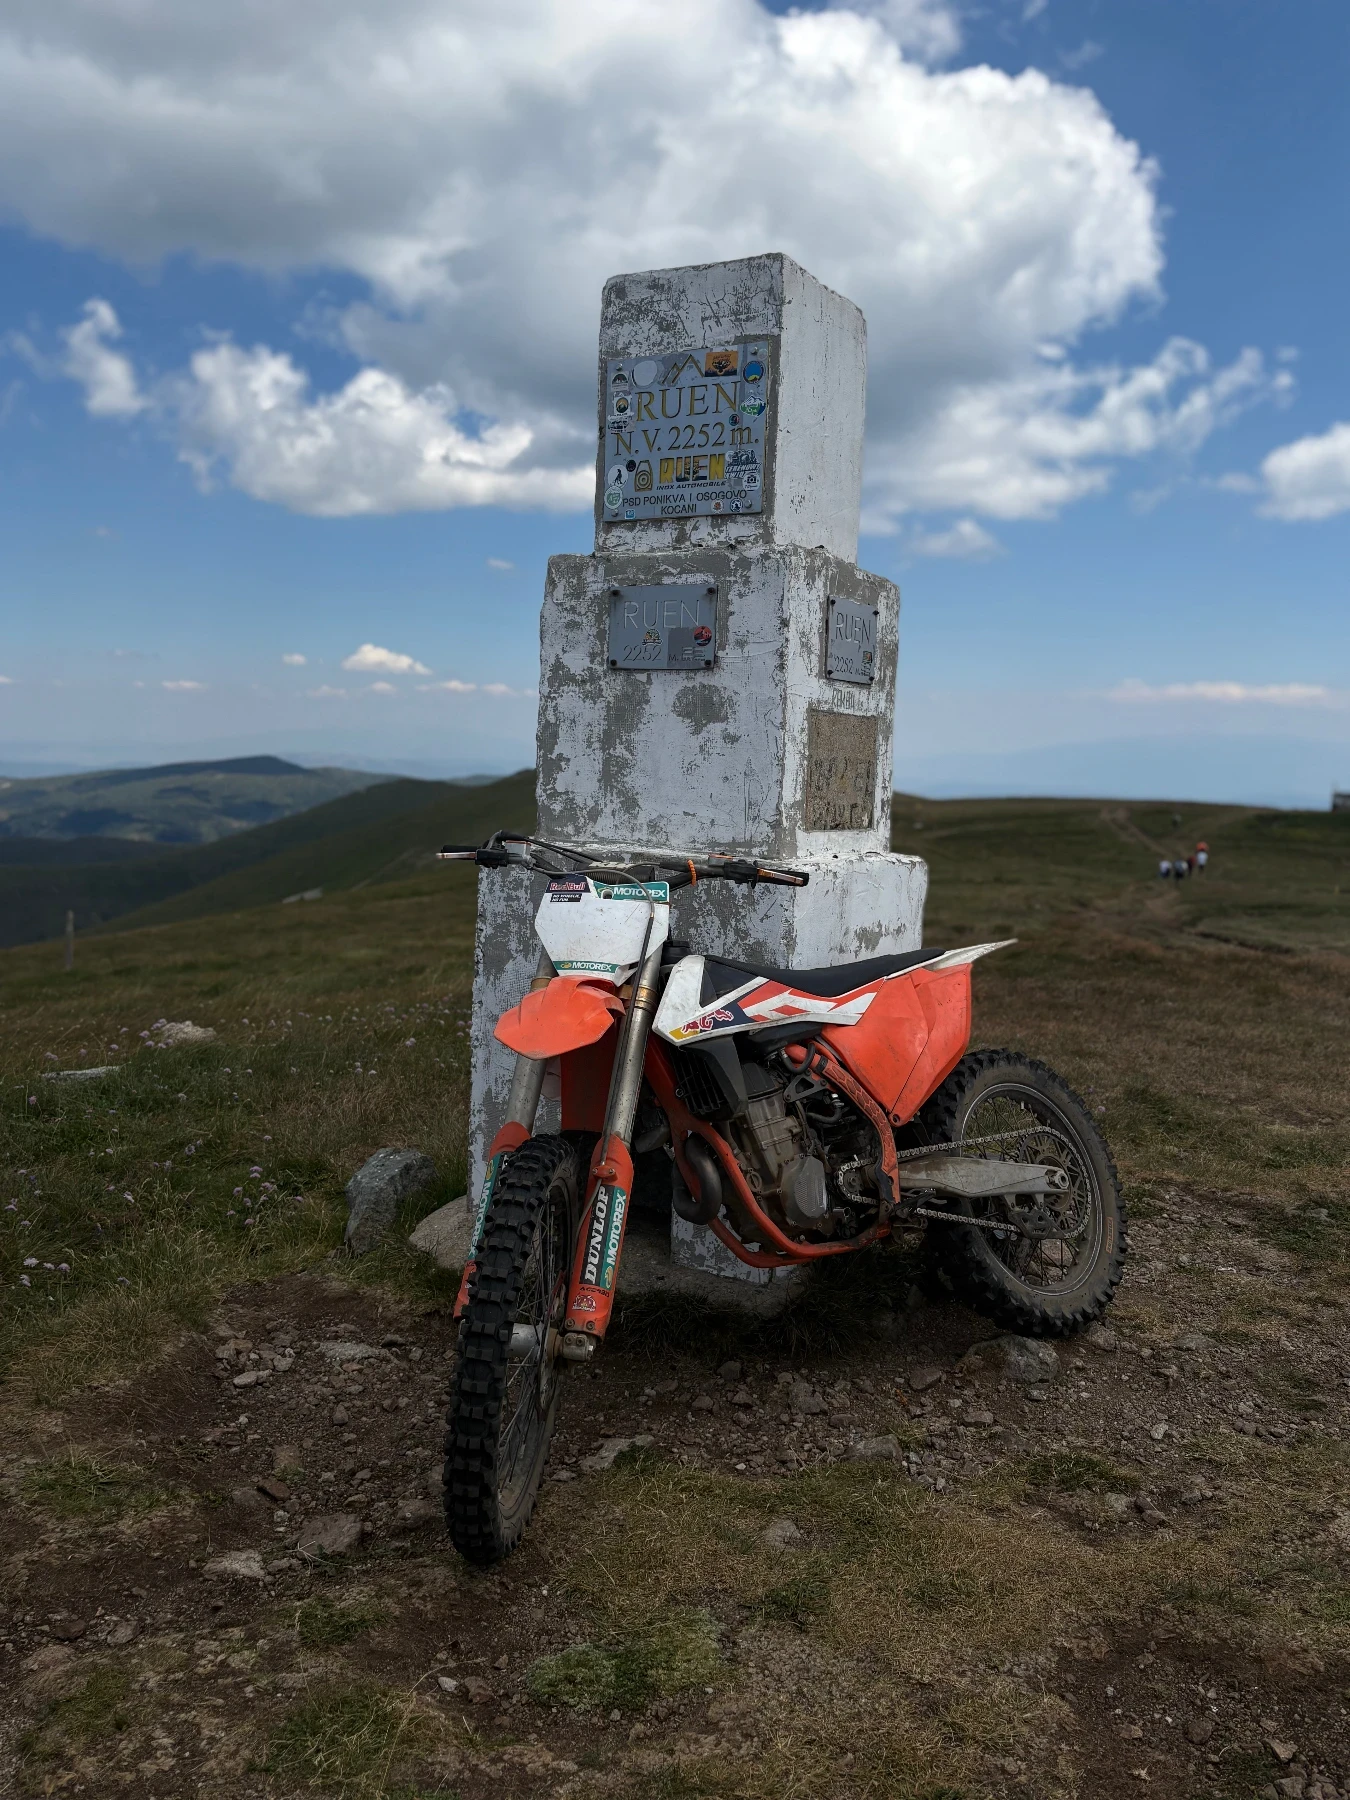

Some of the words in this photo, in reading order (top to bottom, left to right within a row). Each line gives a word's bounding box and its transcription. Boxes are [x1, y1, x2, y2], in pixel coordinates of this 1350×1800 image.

[635, 380, 741, 421] RUEN
[667, 422, 726, 451] 2252
[659, 453, 726, 484] RUEN
[622, 496, 641, 508] PSD
[643, 494, 686, 506] PONIKVA
[696, 489, 748, 503] OSOGOVO
[660, 504, 697, 516] KOCANI
[623, 600, 700, 629] RUEN
[835, 612, 871, 644] RUEN
[622, 645, 662, 662] 2252
[834, 656, 854, 675] 2252
[613, 887, 666, 898] MOTOREX
[571, 961, 612, 972] MOTOREX
[468, 1181, 492, 1257] MOTOREX
[606, 1190, 626, 1266] MOTOREX
[584, 1185, 609, 1285] DUNLOP
